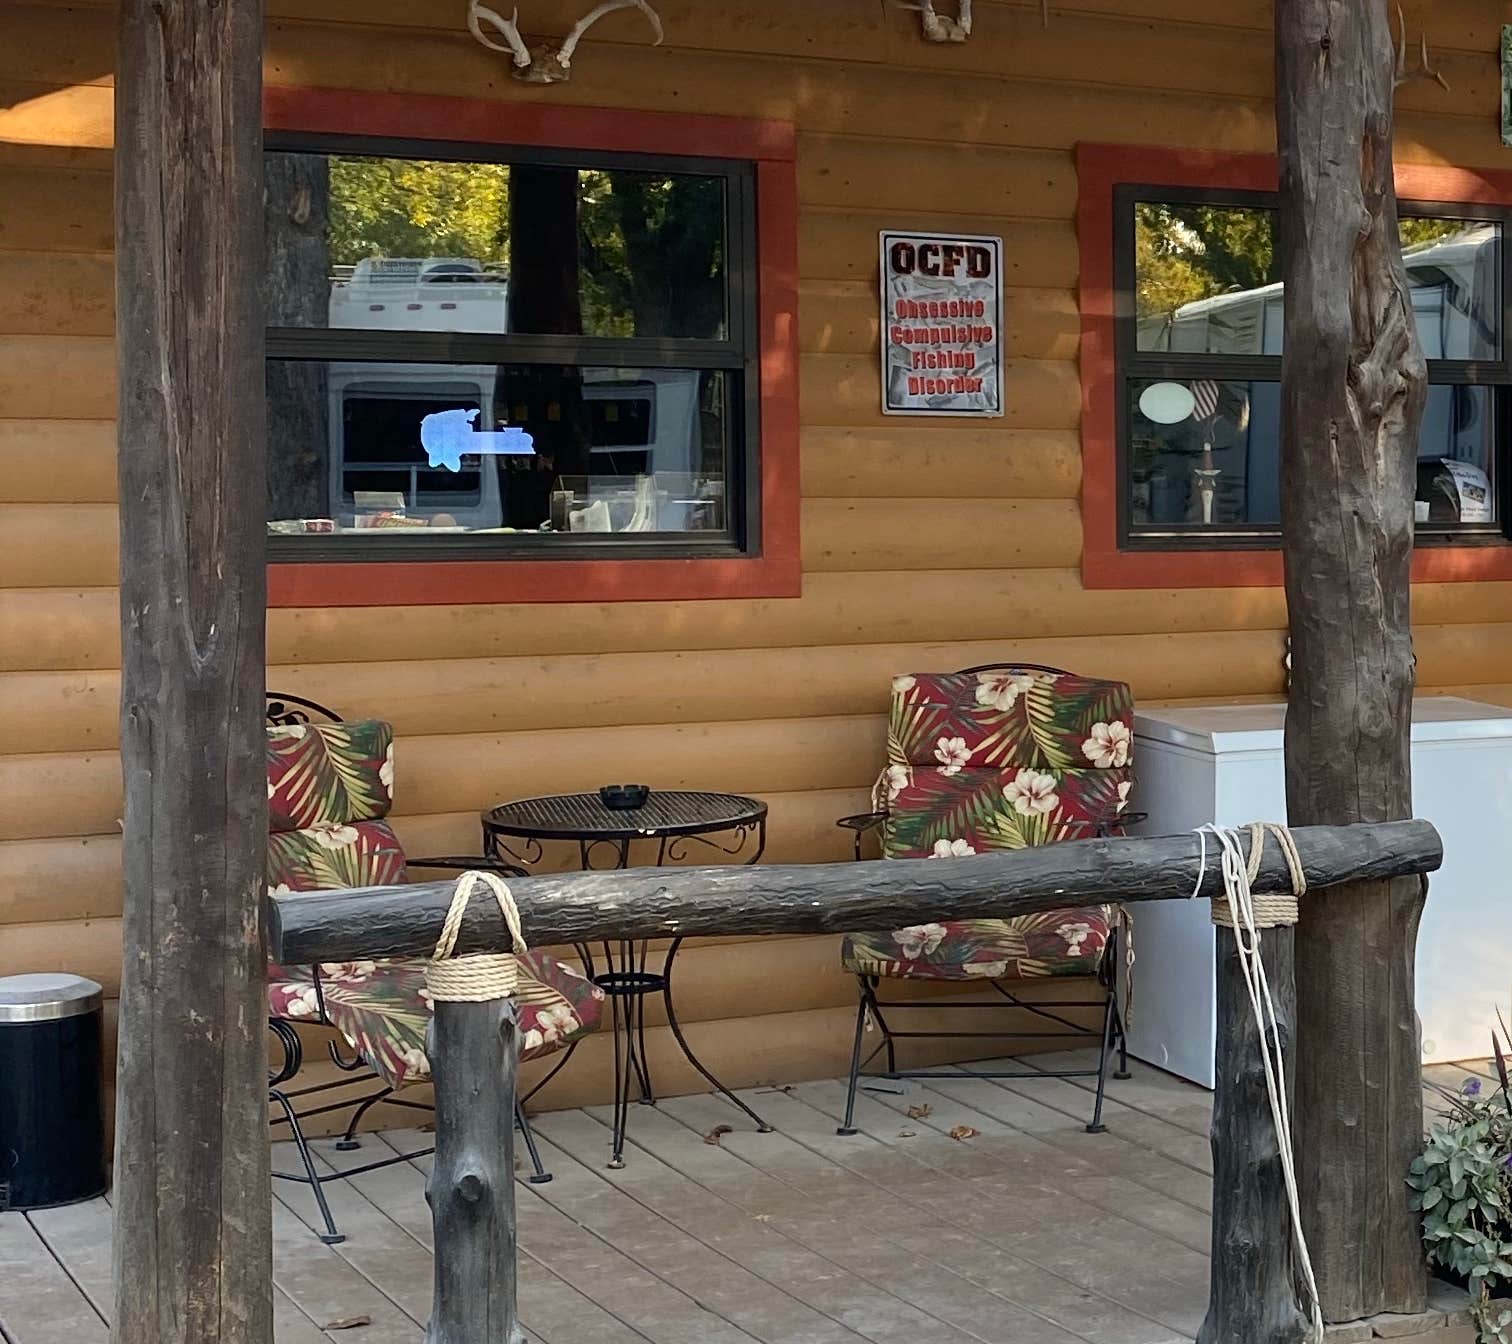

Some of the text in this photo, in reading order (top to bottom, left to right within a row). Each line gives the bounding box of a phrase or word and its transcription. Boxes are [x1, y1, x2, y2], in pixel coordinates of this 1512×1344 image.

[890, 241, 992, 278] OCFD
[895, 298, 985, 319] Obsessive
[889, 323, 993, 346] Compulsive
[911, 350, 976, 370] Fishing
[907, 376, 983, 396] Disorder
